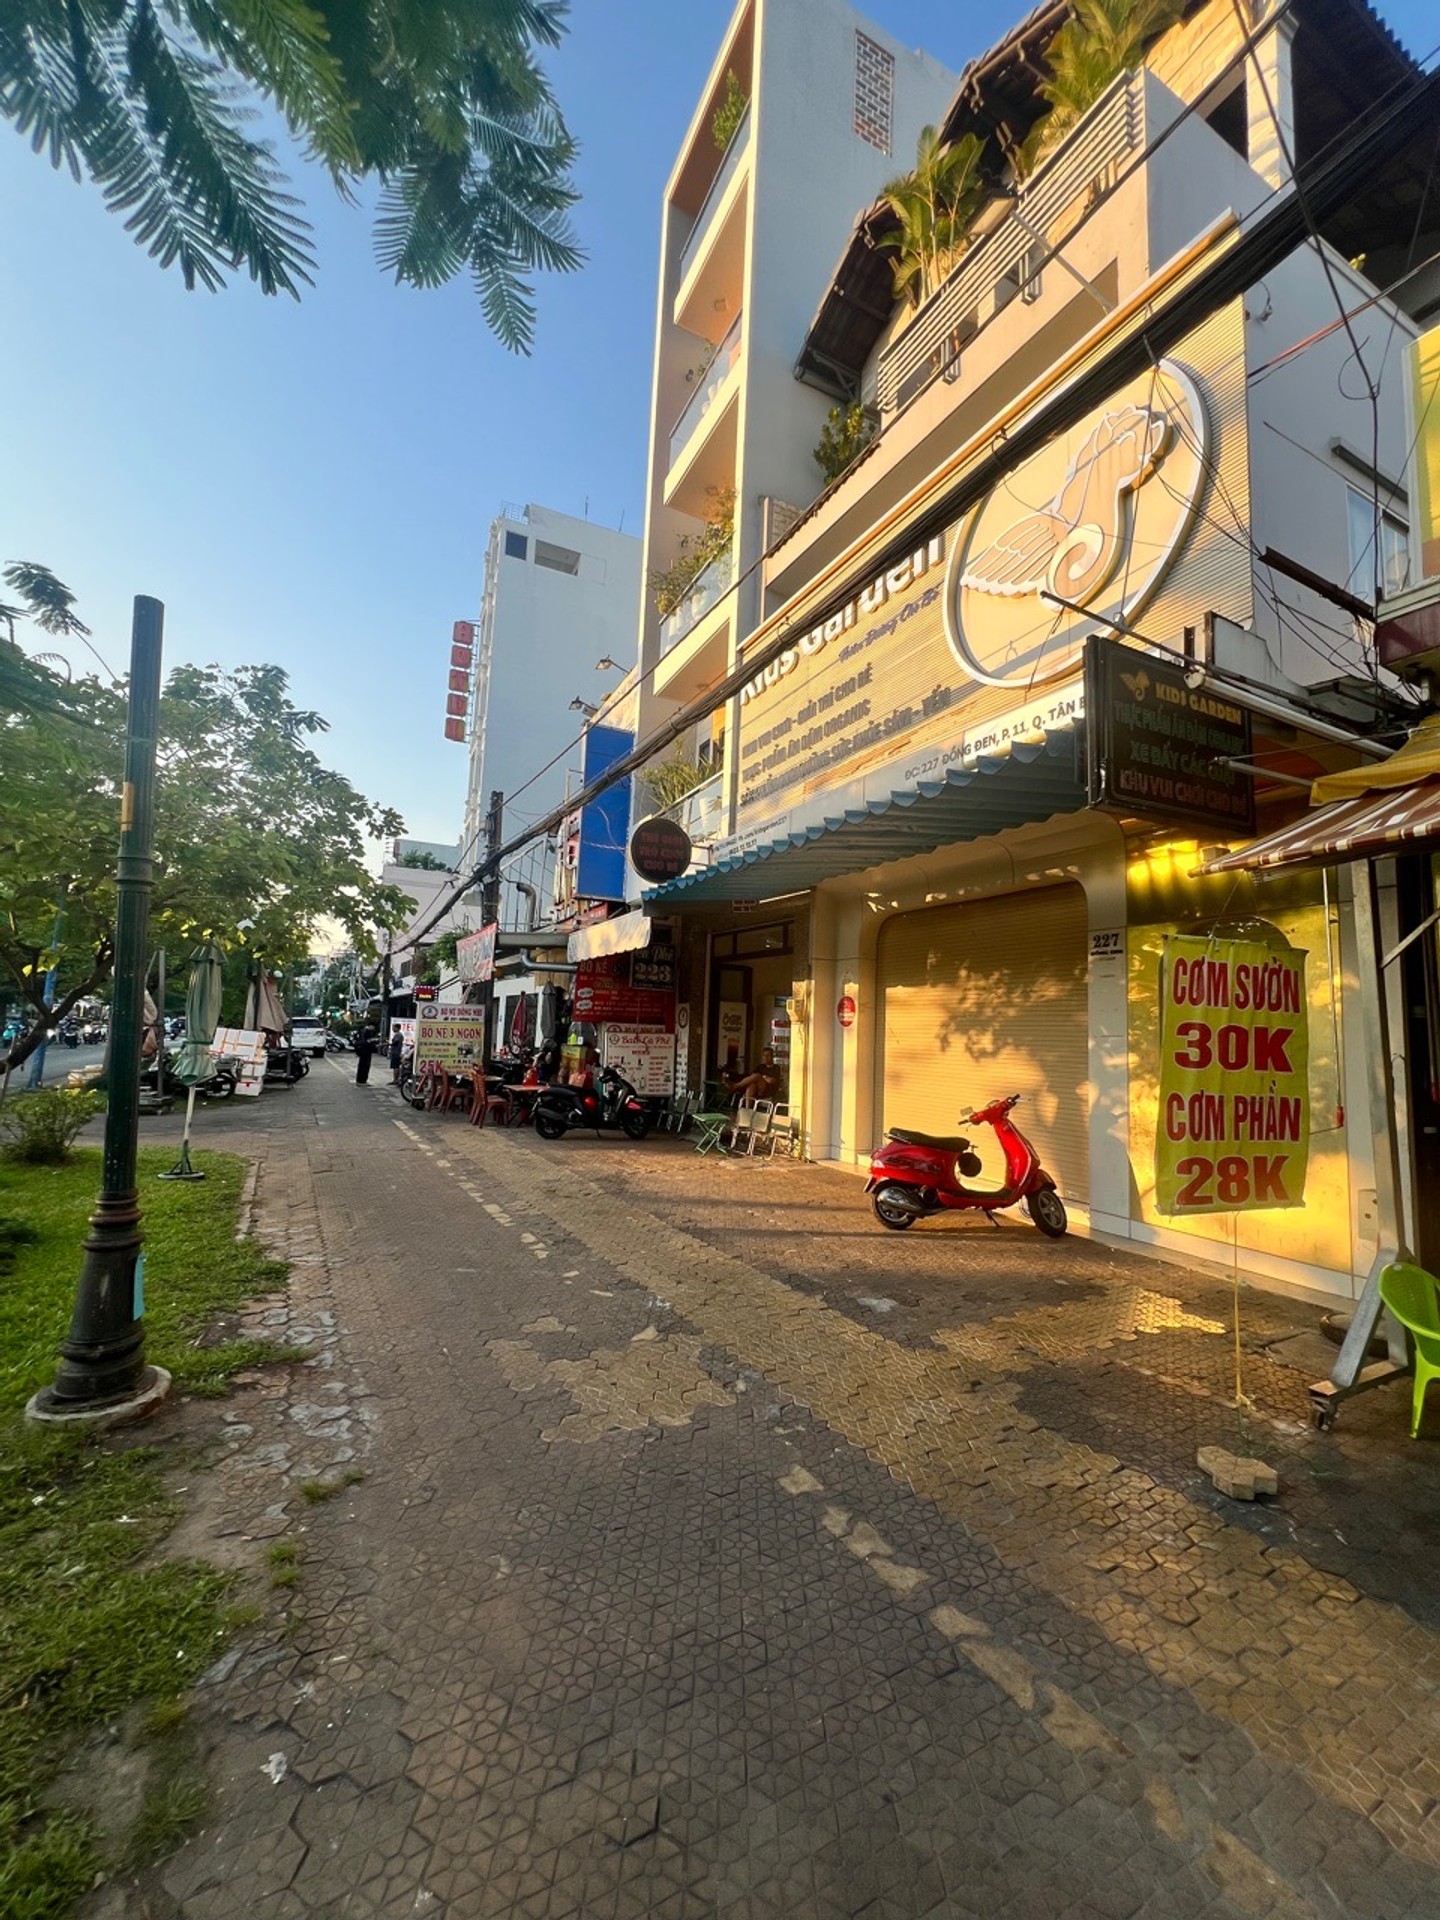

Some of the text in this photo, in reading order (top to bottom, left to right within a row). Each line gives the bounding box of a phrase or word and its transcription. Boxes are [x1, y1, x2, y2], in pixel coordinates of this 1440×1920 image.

[974, 731, 1000, 752] ĐEN,
[1032, 714, 1046, 729] Q.
[1048, 698, 1076, 722] TÂN
[1154, 681, 1243, 726] KIDS GARDEN
[1130, 740, 1150, 763] XE
[1149, 775, 1174, 799] VUI
[1093, 932, 1120, 949] 227
[634, 962, 673, 983] 223
[1172, 953, 1301, 1014] CƠM SƯỜN
[1174, 1020, 1295, 1074] 30K
[1165, 1079, 1302, 1143] CƠM PHẦN
[1175, 1153, 1292, 1207] 28K
